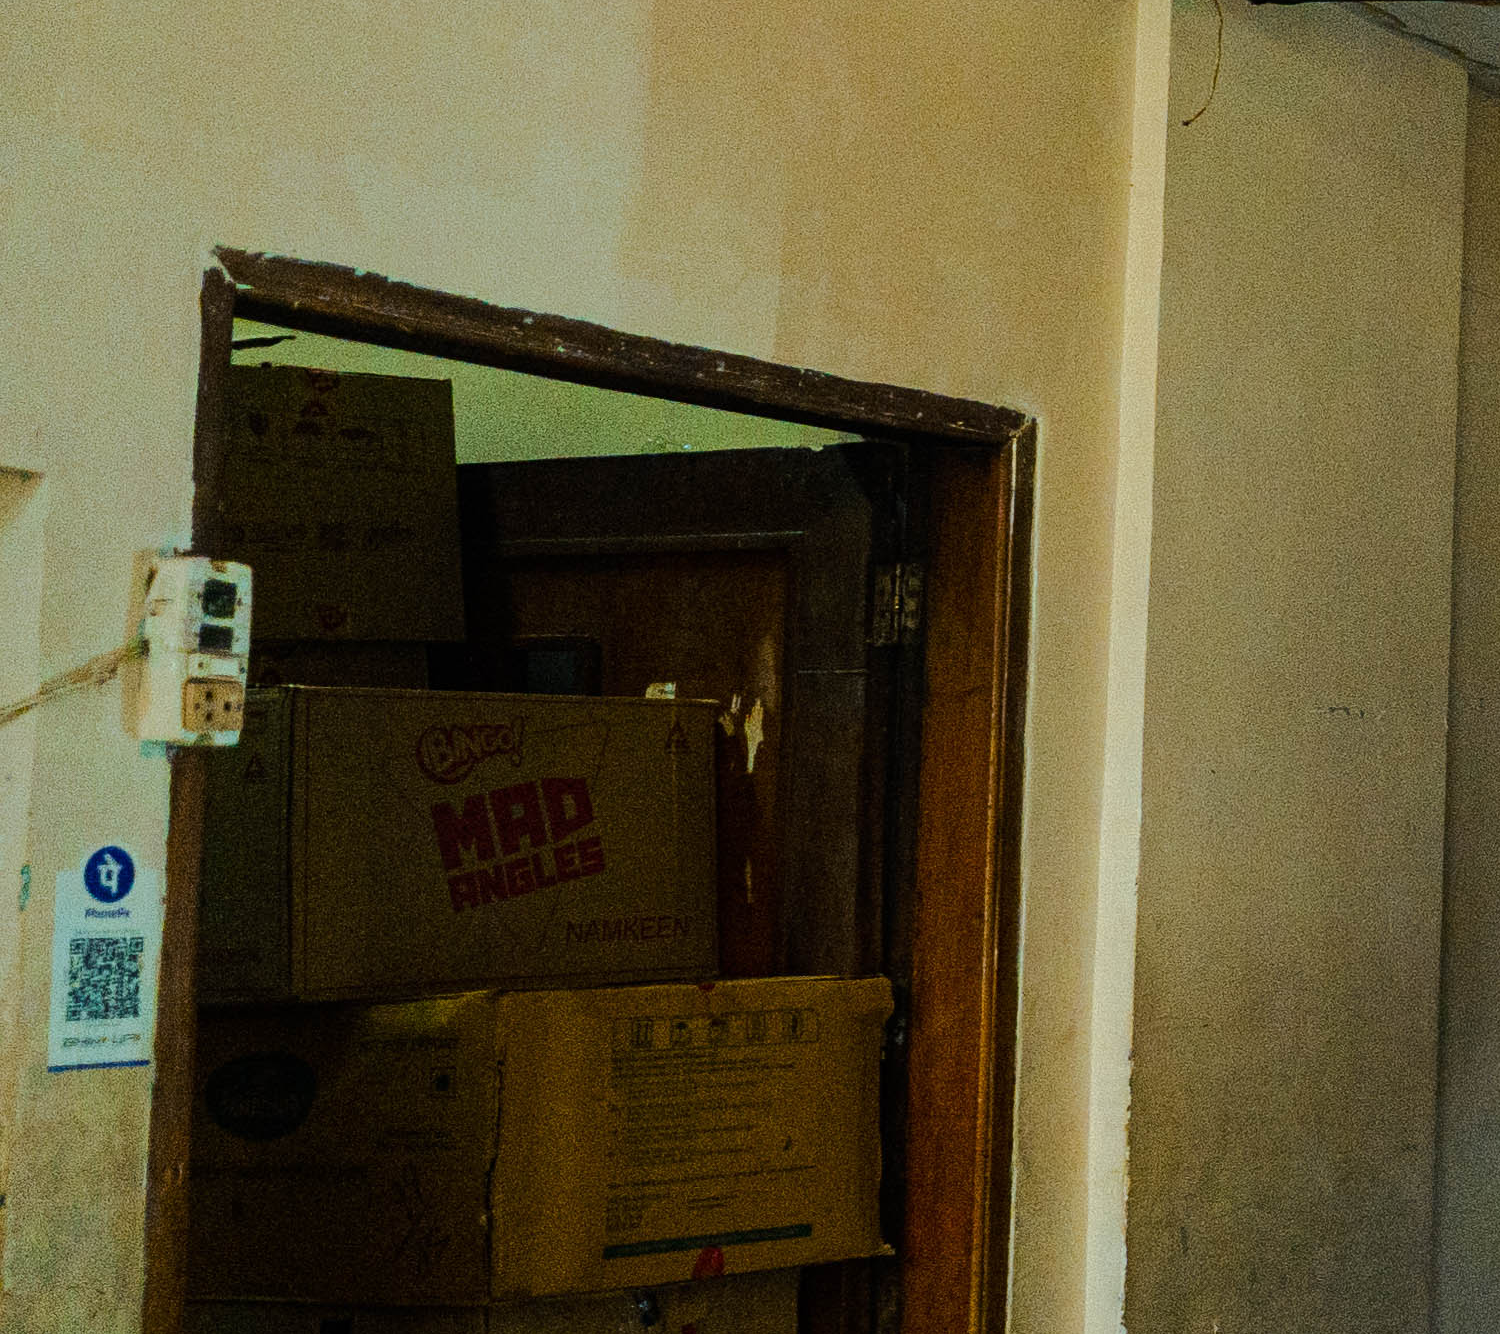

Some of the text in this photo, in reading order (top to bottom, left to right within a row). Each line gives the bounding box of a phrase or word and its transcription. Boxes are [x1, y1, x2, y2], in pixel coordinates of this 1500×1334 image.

[431, 777, 594, 869] MAD
[447, 838, 606, 914] ANGLES
[567, 917, 689, 946] NAMKEEN
